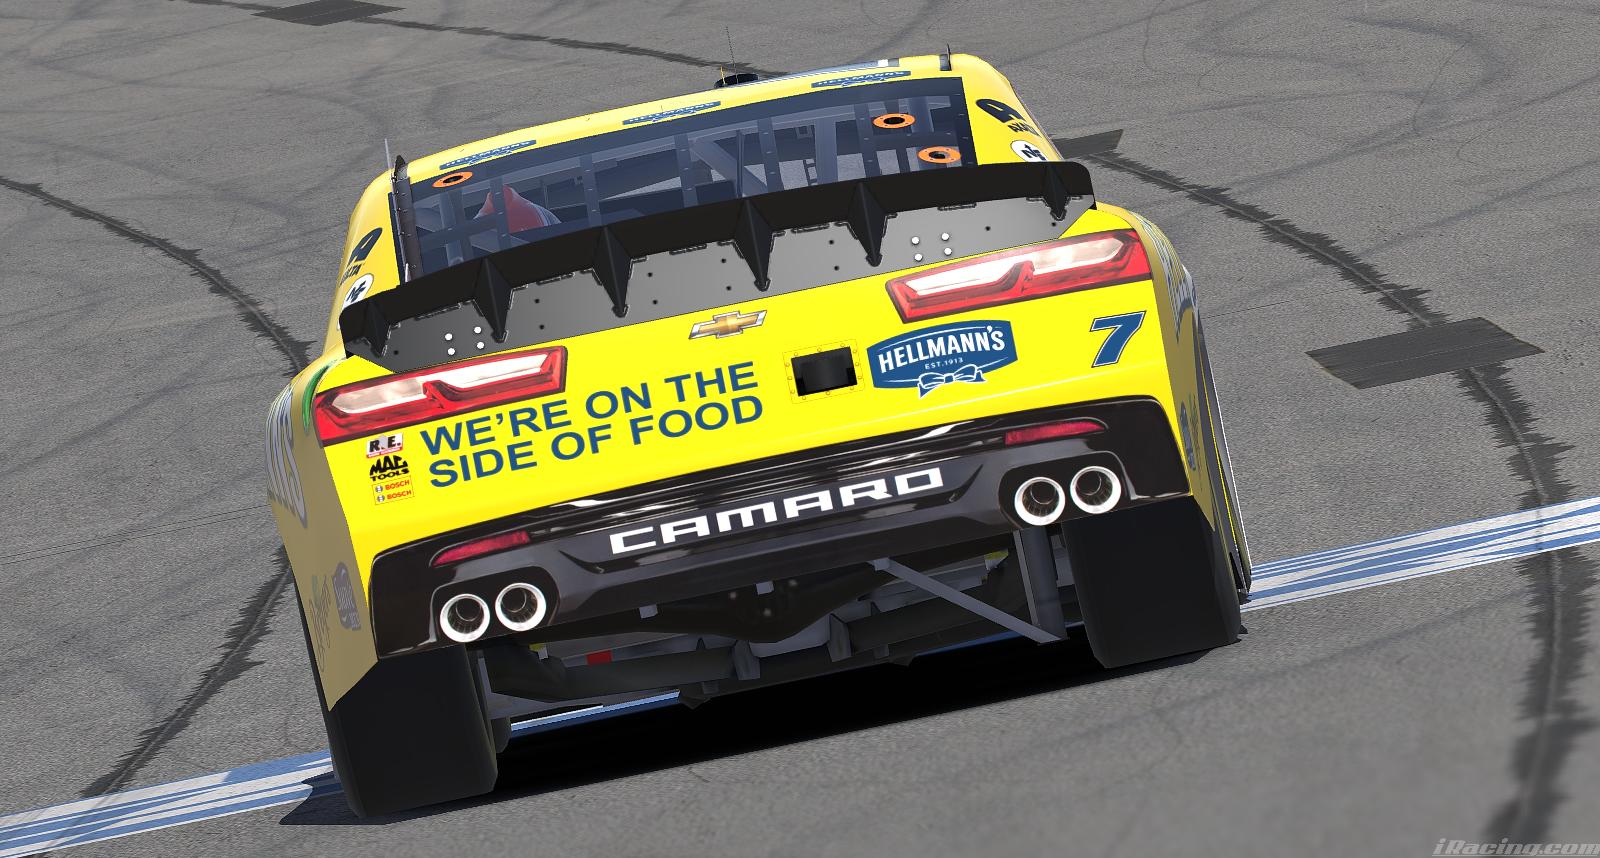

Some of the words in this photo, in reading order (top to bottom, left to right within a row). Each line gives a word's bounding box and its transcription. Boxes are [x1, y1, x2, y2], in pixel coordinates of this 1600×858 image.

[877, 325, 1006, 374] HELLMANN'S
[1090, 311, 1146, 368] 7
[420, 399, 571, 456] WE'RE
[585, 382, 653, 420] ON
[664, 361, 759, 405] THE
[369, 455, 408, 475] MAC
[429, 440, 538, 488] SIDE
[550, 423, 612, 461] OF
[629, 394, 763, 446] FOOD
[370, 468, 409, 481] TOOLS
[385, 480, 410, 490] BOSCH
[387, 490, 411, 499] BOSCH
[609, 467, 945, 555] CAMARO
